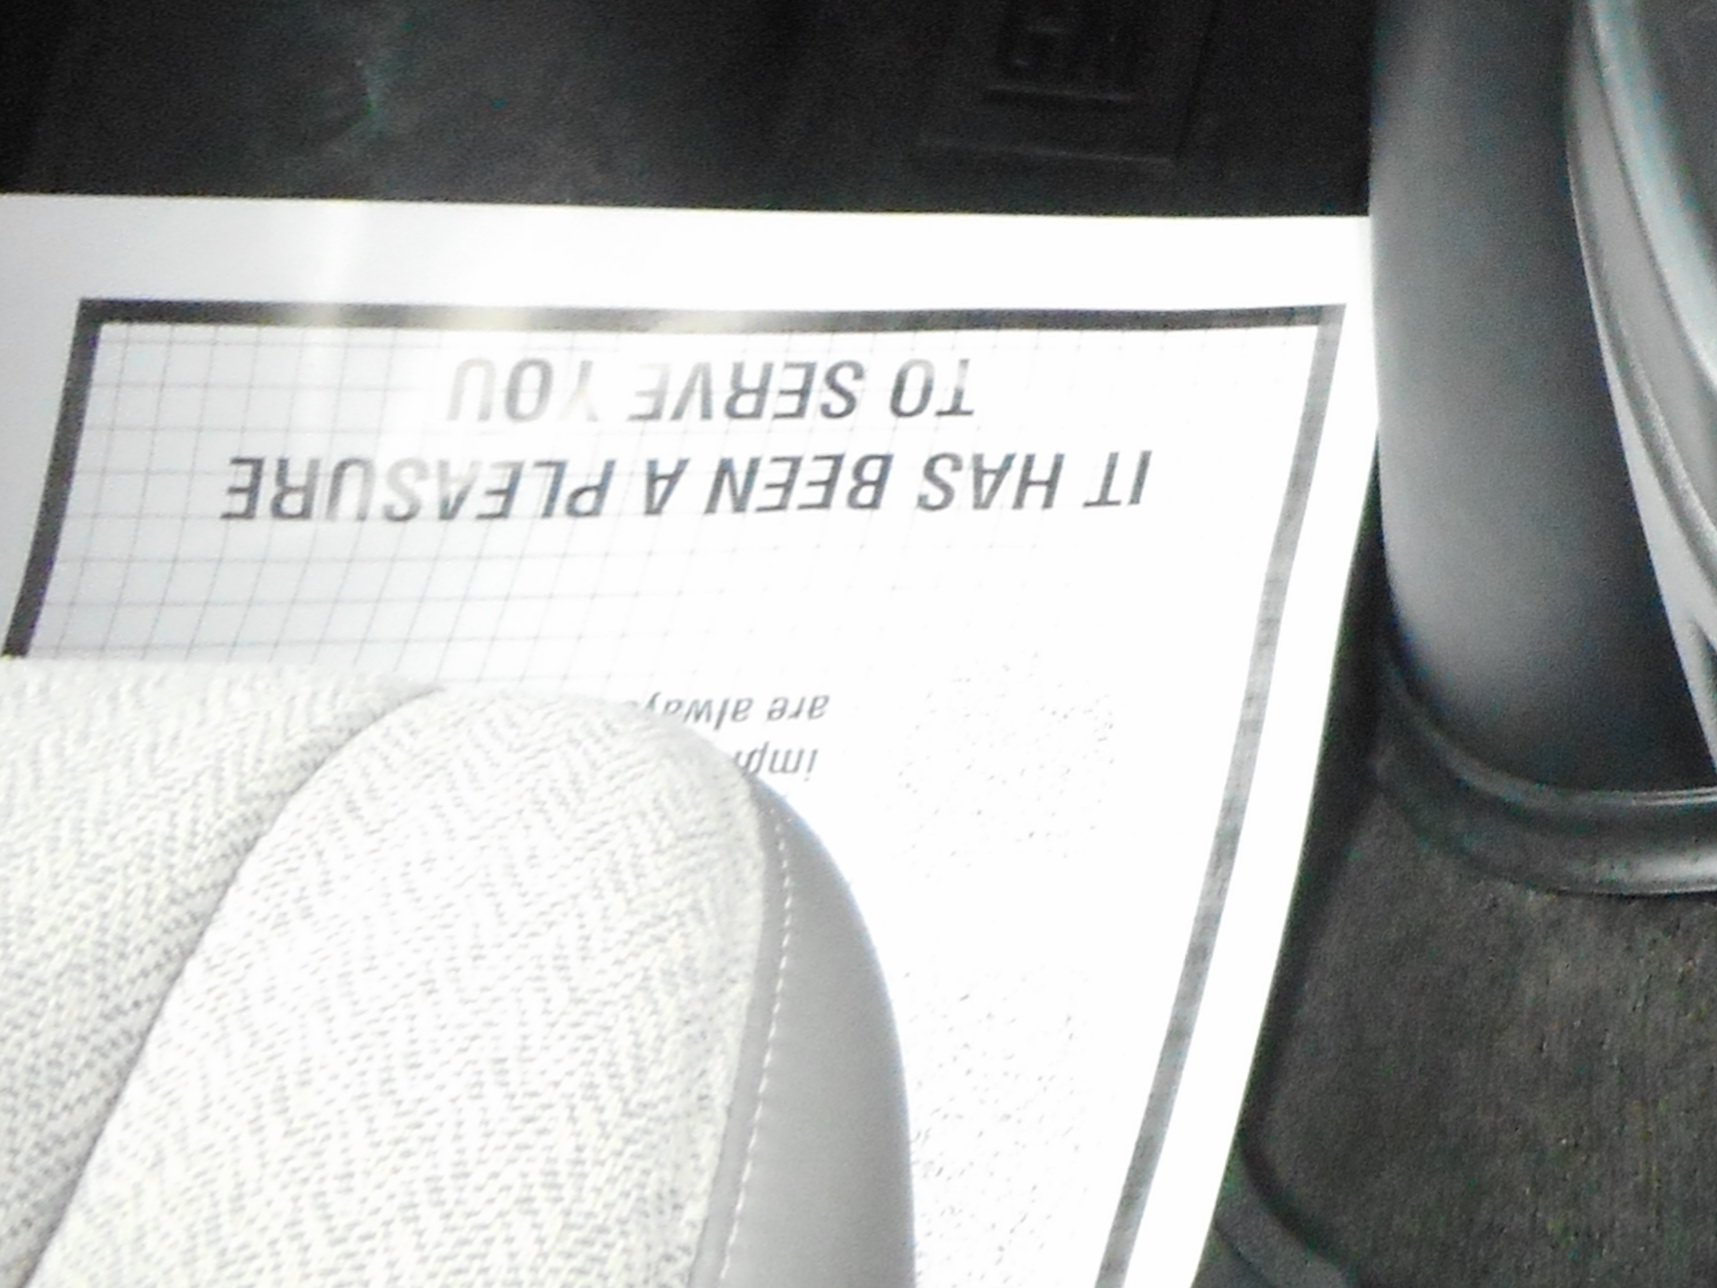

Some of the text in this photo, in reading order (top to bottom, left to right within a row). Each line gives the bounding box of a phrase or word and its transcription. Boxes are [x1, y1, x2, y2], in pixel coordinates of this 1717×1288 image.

[447, 357, 977, 424] TO SERVE YOU
[219, 449, 1151, 522] IT HAS BEEN A PLEASURE
[767, 696, 830, 722] are
